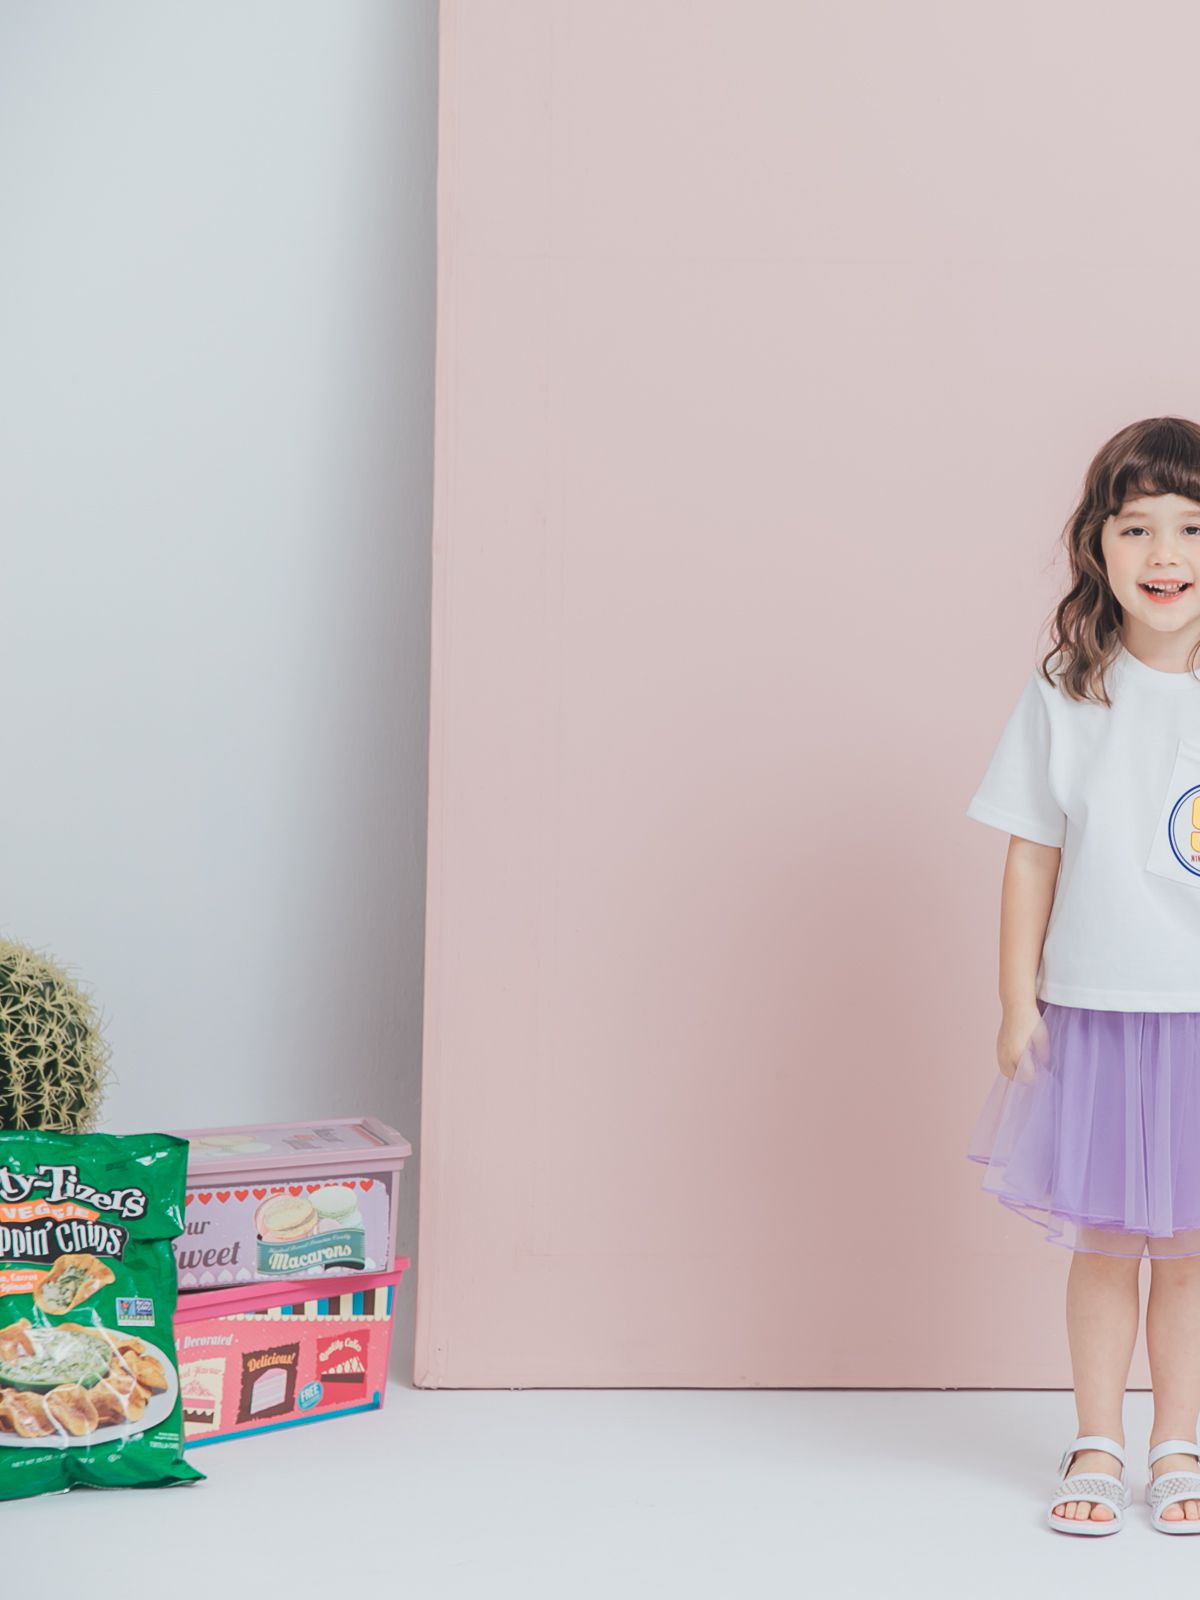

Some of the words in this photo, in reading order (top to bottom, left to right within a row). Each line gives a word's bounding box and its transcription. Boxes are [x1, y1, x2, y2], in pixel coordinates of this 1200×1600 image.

[0, 1165, 146, 1218] ty-Tizers
[1, 1202, 90, 1219] VEGGIE
[184, 1220, 211, 1236] ur
[0, 1220, 53, 1258] ppin'
[55, 1220, 122, 1255] Chips
[172, 1241, 241, 1270] weet
[268, 1244, 352, 1270] Macarons
[183, 1333, 235, 1349] Decorated
[247, 1352, 296, 1373] Delicious!
[301, 1382, 320, 1403] FREE
